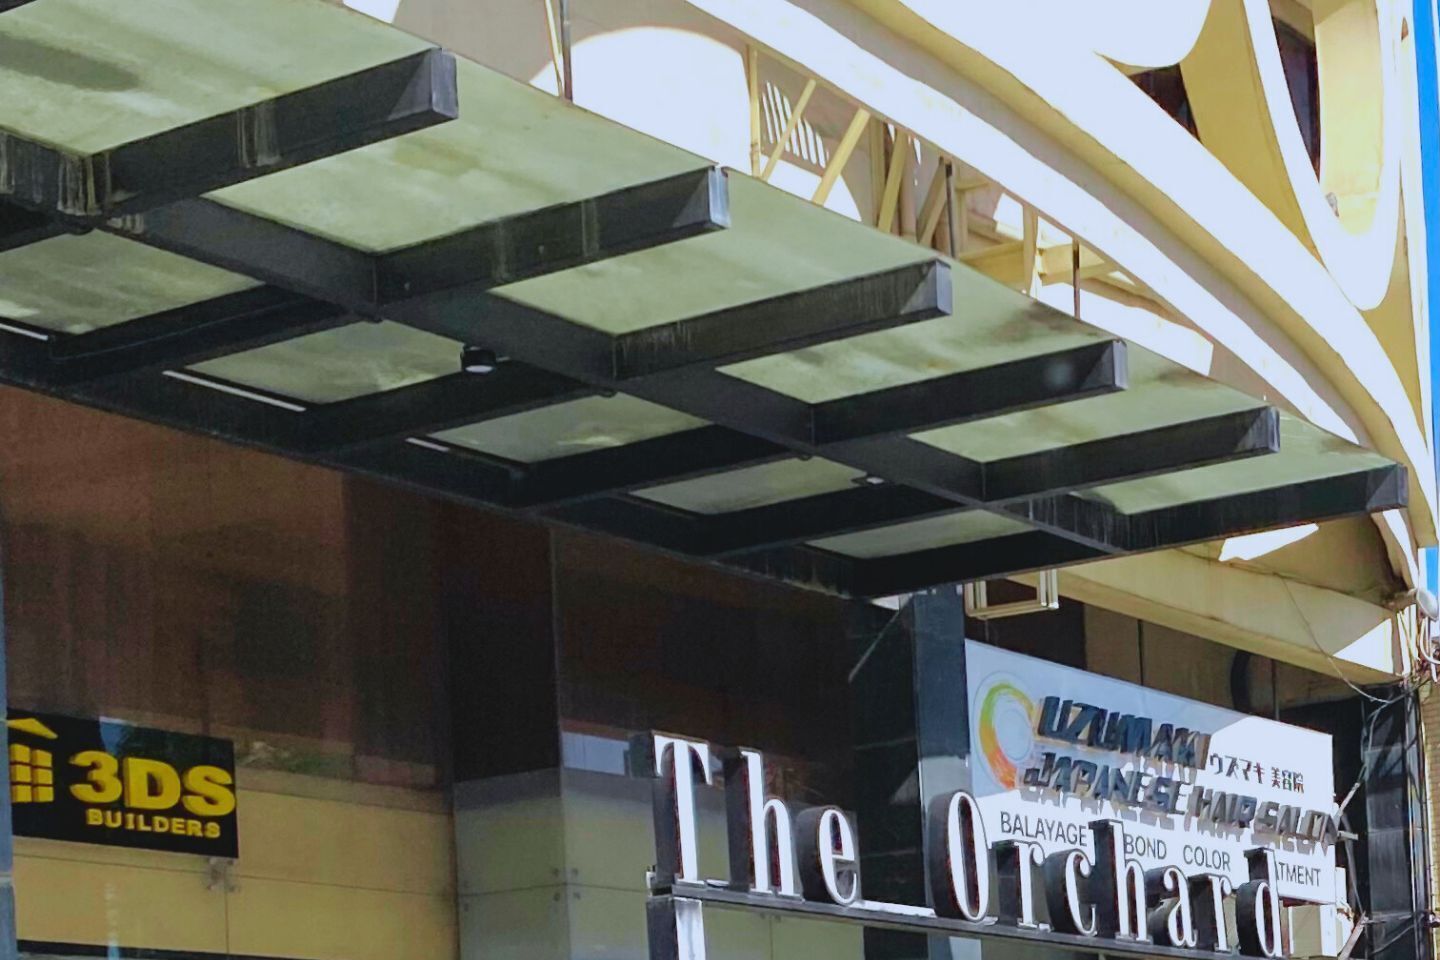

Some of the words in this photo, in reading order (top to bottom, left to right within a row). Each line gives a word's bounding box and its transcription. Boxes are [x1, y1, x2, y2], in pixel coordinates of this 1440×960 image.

[1038, 696, 1211, 770] UZUMAKI
[68, 750, 237, 817] 3DS
[1023, 752, 1186, 815] JAPANESE
[1186, 785, 1258, 829] HAIR
[1254, 800, 1339, 845] SALON
[86, 807, 221, 839] BUILDERS
[650, 731, 861, 906] The
[937, 790, 1286, 959] Orchard
[999, 810, 1088, 848] BALAYAGE
[1123, 833, 1167, 861] BOND
[1182, 844, 1231, 873] COLOR
